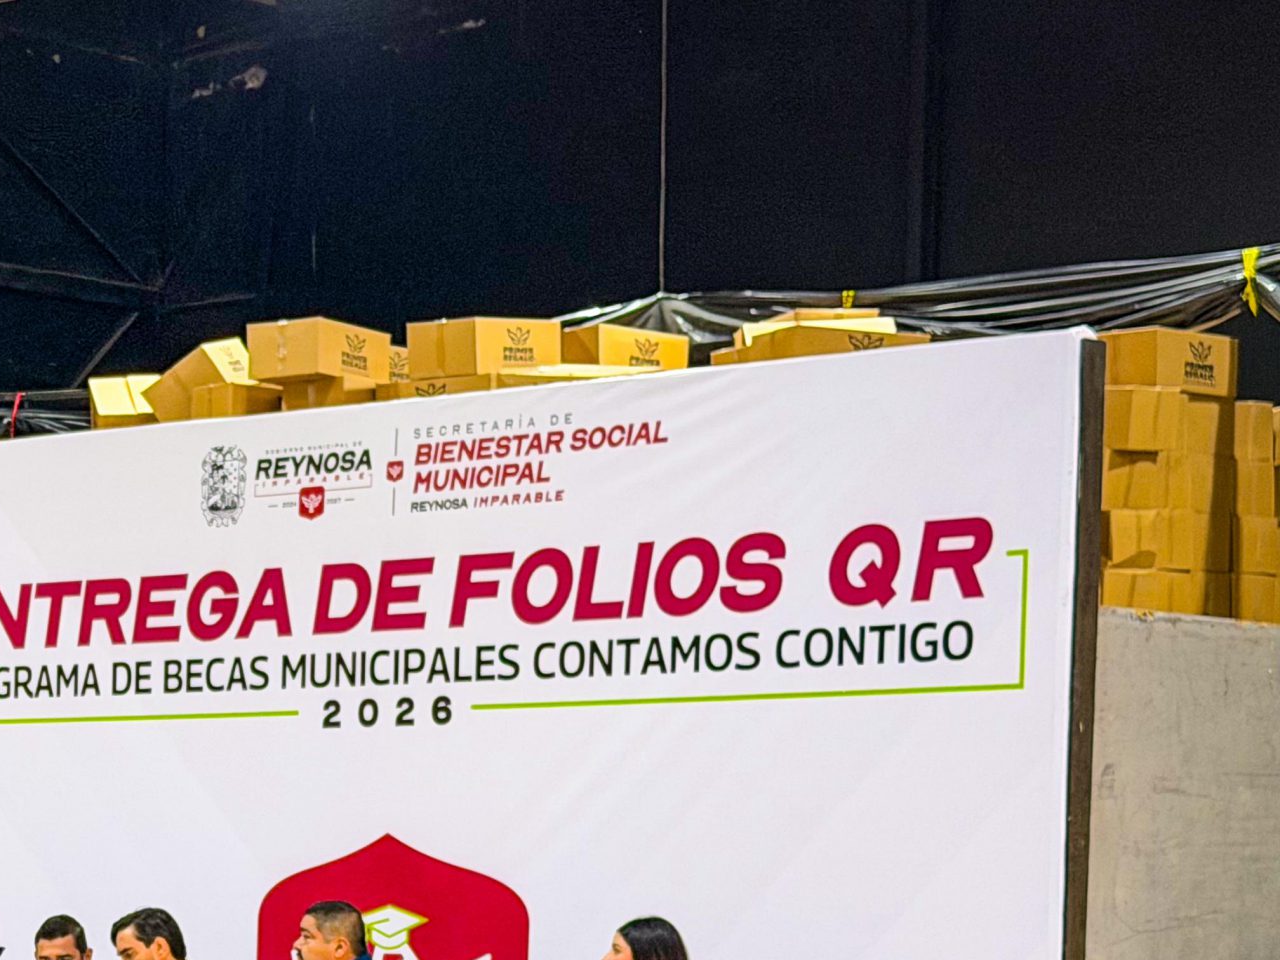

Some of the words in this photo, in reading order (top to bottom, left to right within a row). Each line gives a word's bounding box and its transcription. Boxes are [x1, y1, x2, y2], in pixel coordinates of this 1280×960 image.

[413, 413, 536, 439] SECRETARÍA
[550, 412, 573, 426] DE
[414, 430, 565, 466] BIENESTAR
[570, 420, 668, 452] SOCIAL
[255, 448, 372, 480] REYNOSA
[413, 461, 551, 494] MUNICIPAL
[410, 498, 468, 513] REYNOSA
[473, 490, 565, 508] IMPARABLE
[312, 557, 435, 636] DE
[449, 531, 787, 628] FOLIOS
[829, 516, 994, 609] QR
[113, 661, 152, 696] DE
[163, 655, 270, 694] BECAS
[282, 644, 520, 690] MUNICIPALES
[533, 630, 762, 679] CONTAMOS
[775, 620, 974, 668] CONTIGO
[322, 695, 453, 728] 2026
